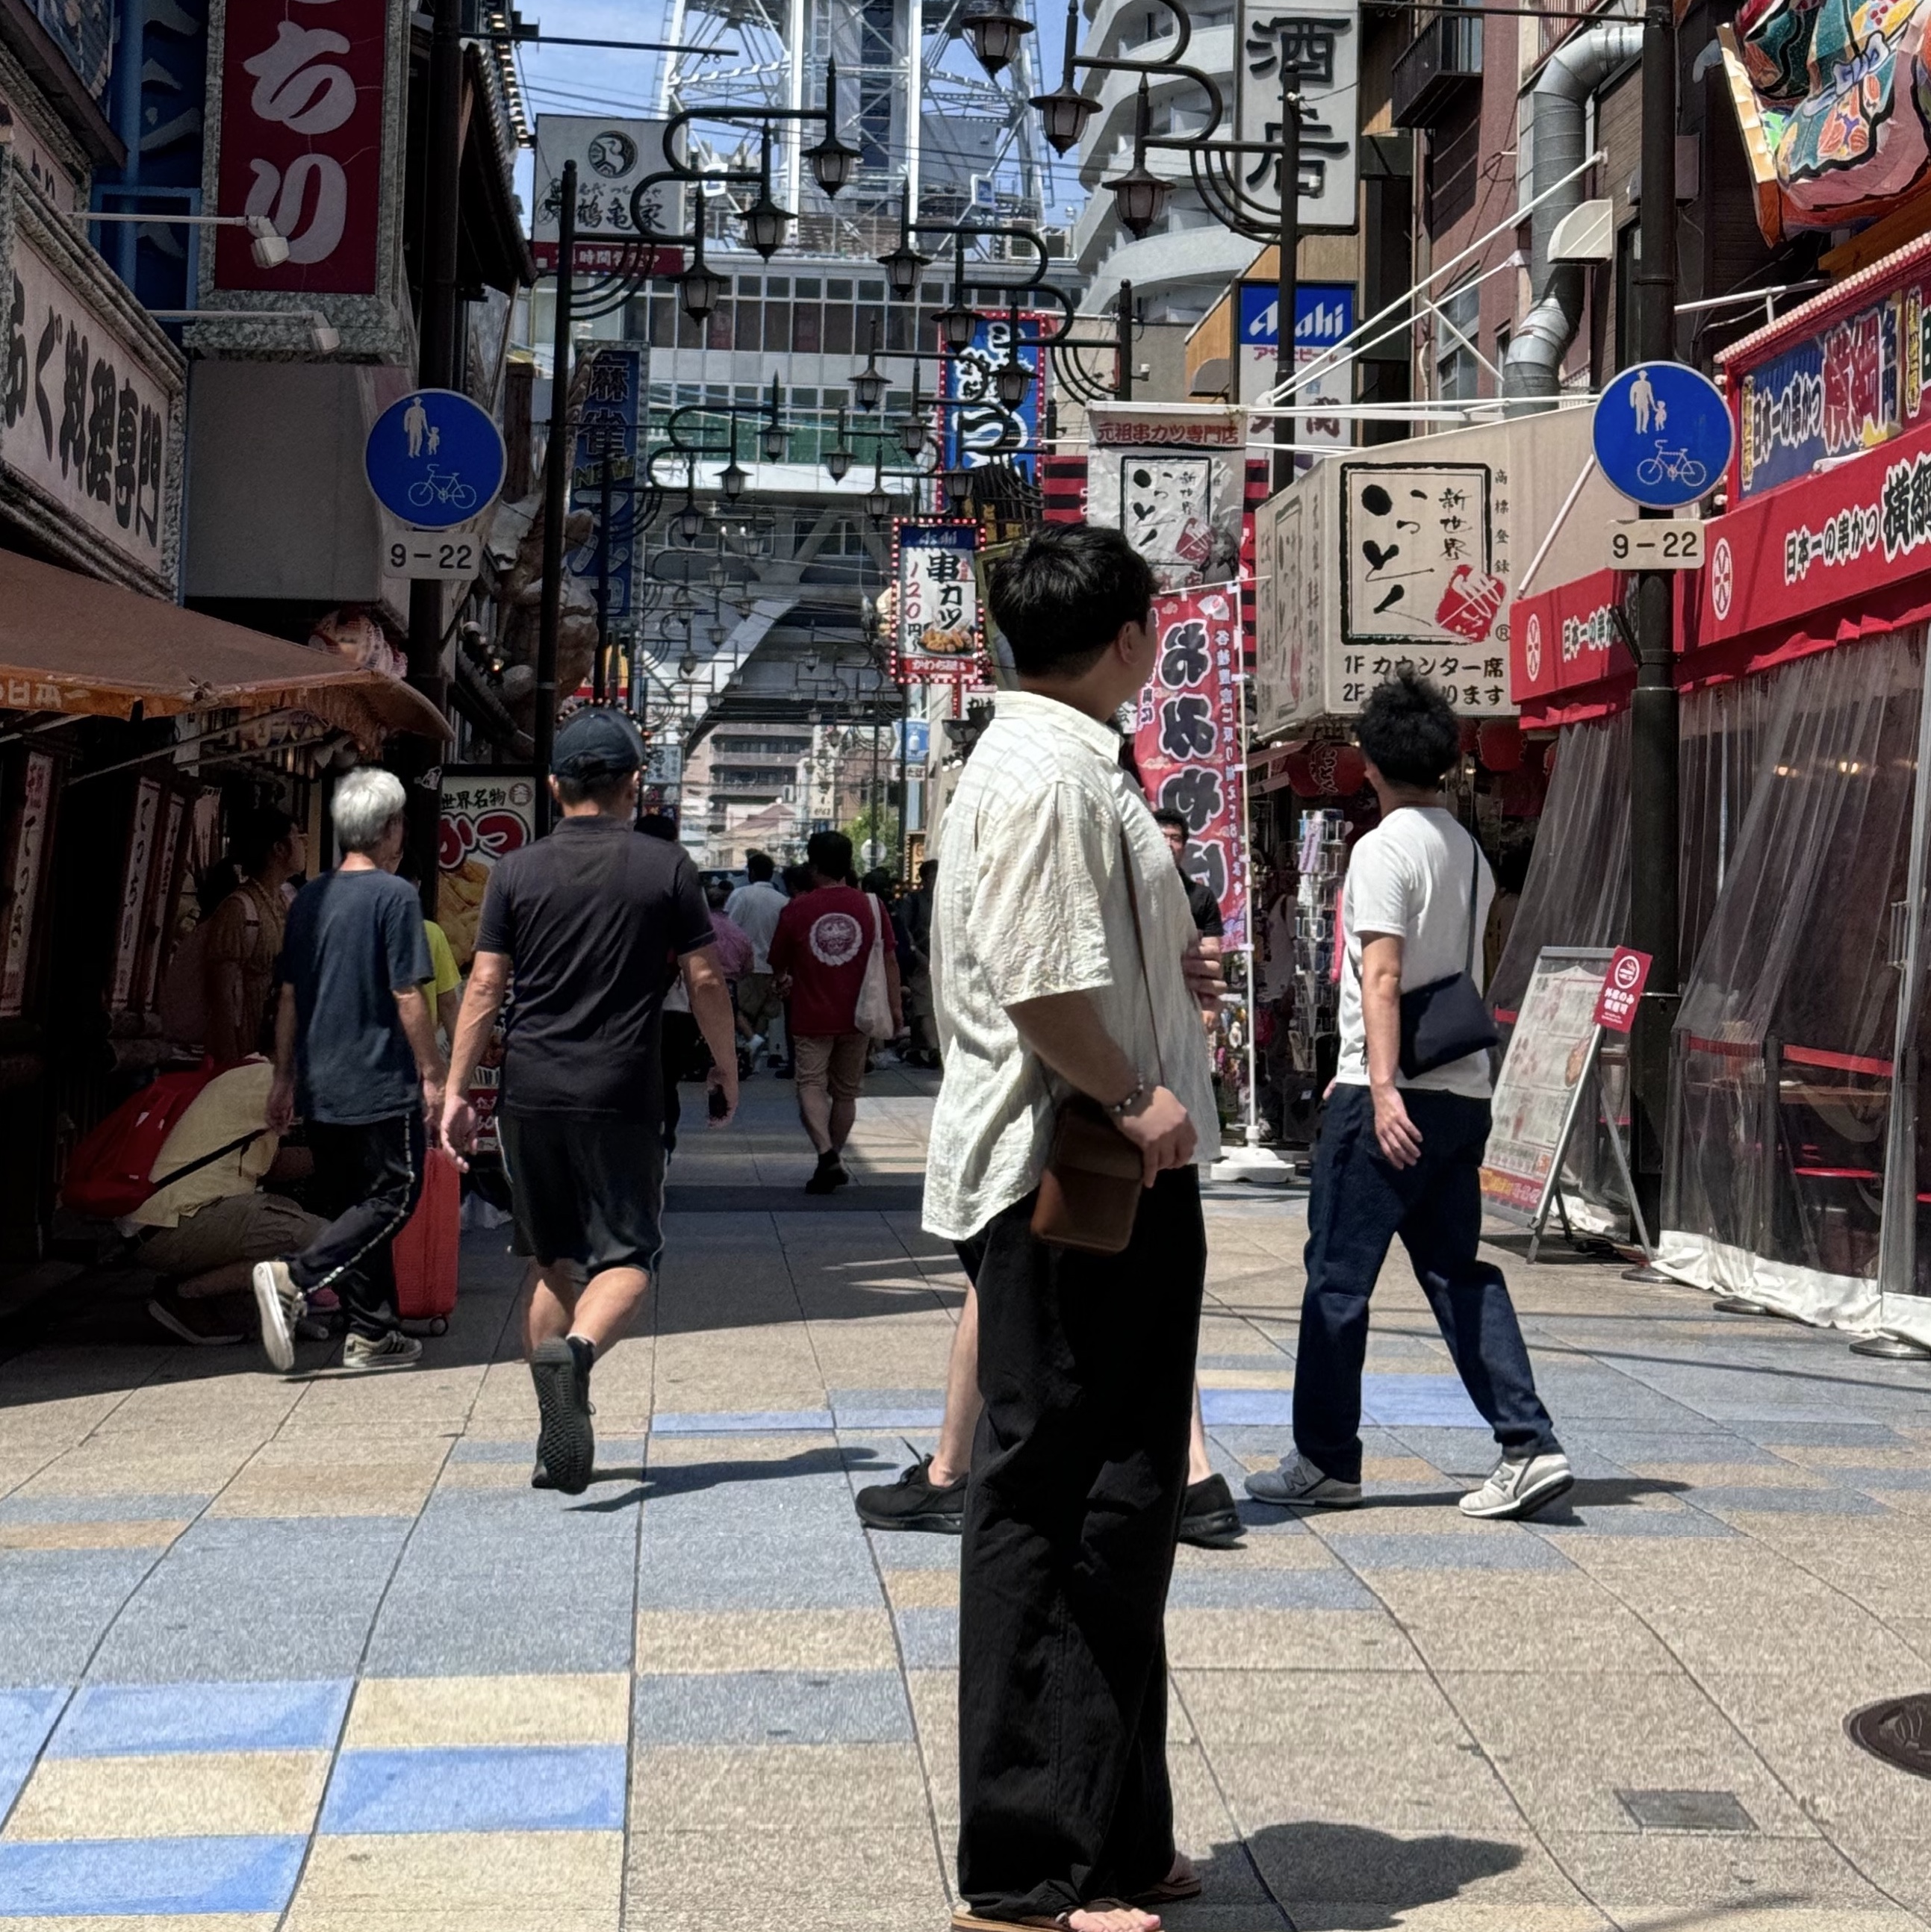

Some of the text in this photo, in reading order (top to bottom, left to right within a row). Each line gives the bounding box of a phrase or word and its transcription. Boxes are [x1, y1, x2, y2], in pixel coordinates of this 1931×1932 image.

[1246, 16, 1352, 199] 酒店
[242, 0, 357, 264] ちり
[1249, 300, 1343, 337] Aahi
[1098, 423, 1238, 446] 元祖串カツ専門店
[1439, 487, 1473, 561] 新世界
[926, 551, 961, 630] 串カツ
[1344, 655, 1365, 675] 1F
[0, 678, 90, 708] 日本一
[1343, 683, 1365, 702] 2F
